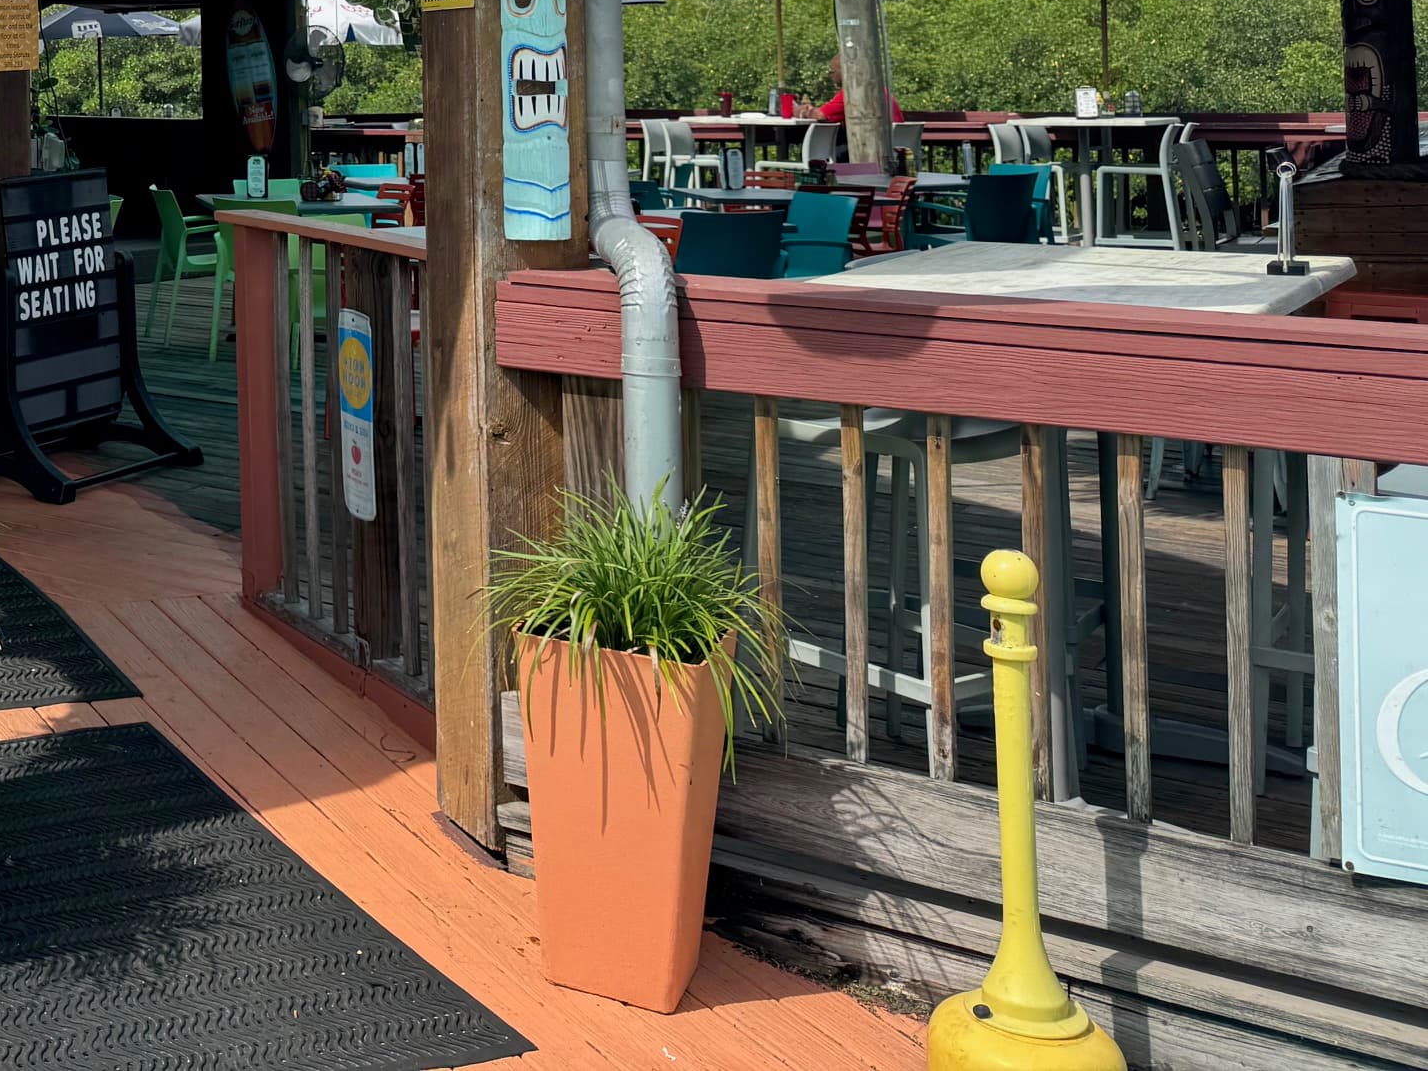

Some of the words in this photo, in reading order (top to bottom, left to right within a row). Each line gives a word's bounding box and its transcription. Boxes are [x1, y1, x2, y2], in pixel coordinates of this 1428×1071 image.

[36, 212, 102, 248] PLEASE
[17, 252, 59, 285] WAIT
[74, 245, 105, 275] FOR
[19, 280, 96, 321] SEATING
